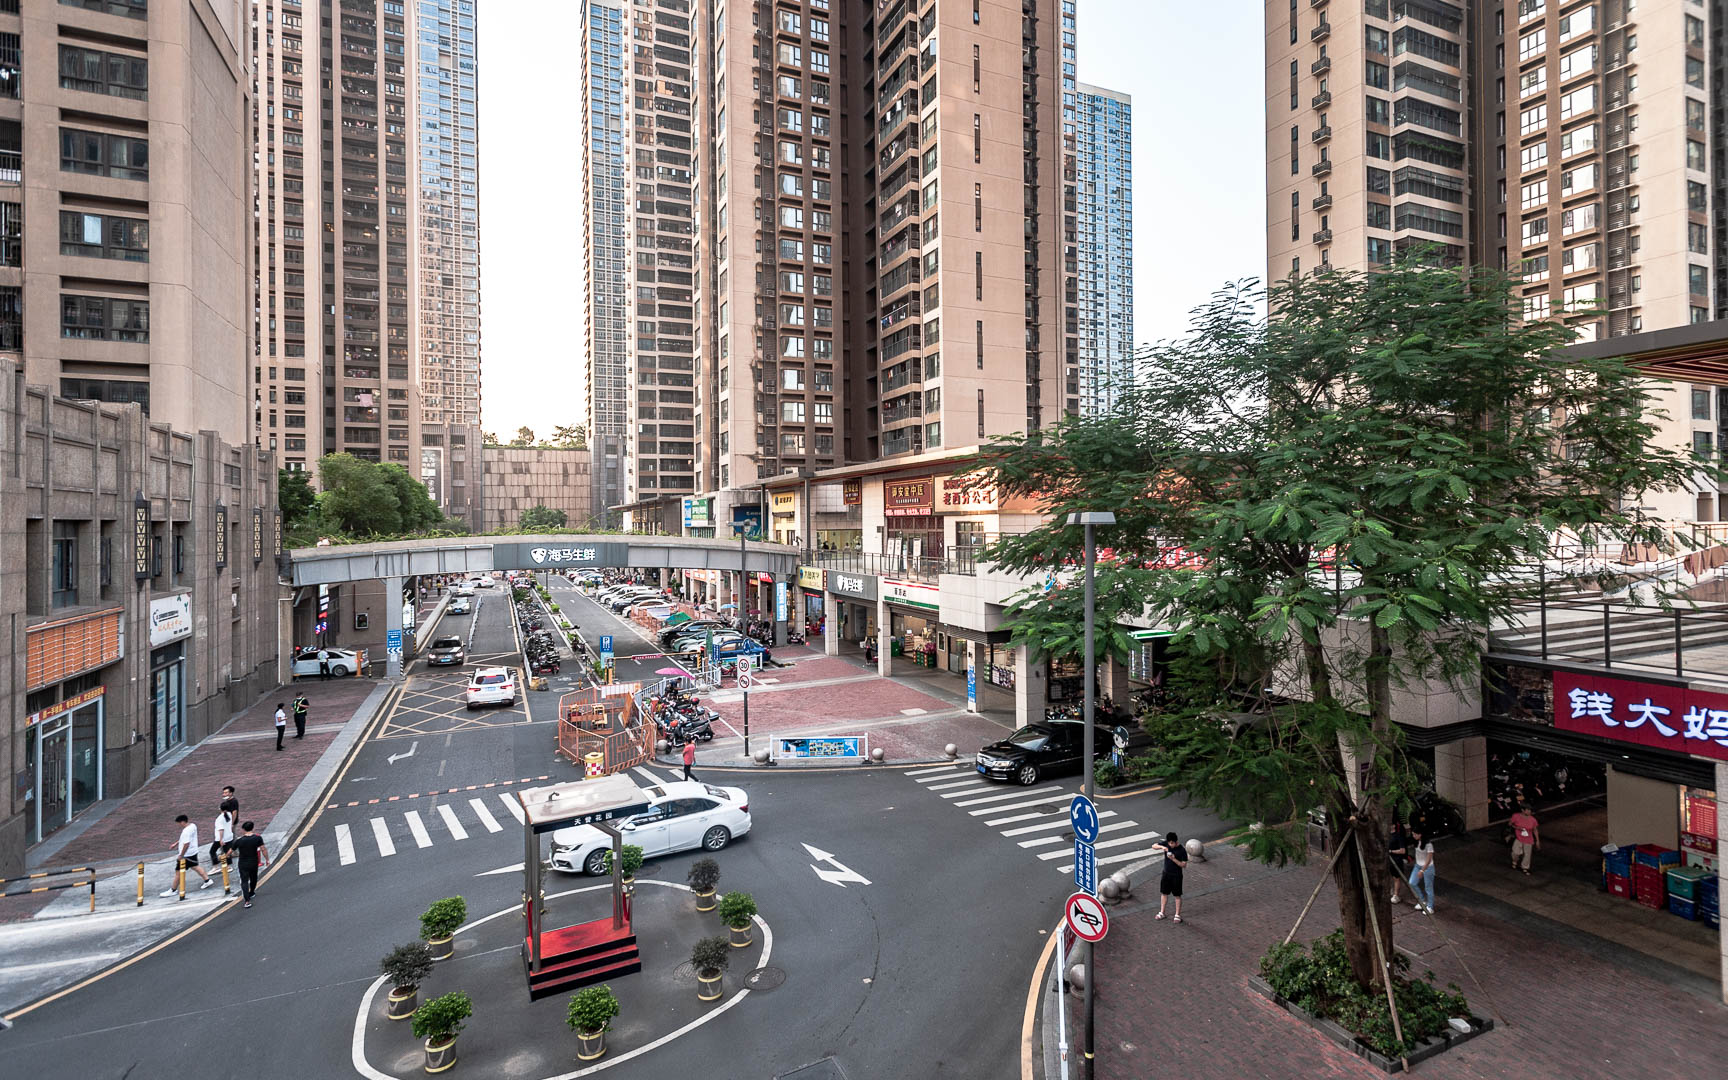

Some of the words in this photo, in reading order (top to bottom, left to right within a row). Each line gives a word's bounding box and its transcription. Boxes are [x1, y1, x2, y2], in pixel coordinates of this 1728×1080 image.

[548, 548, 596, 561] 海马生鲜
[1568, 687, 1728, 747] 钱大妈
